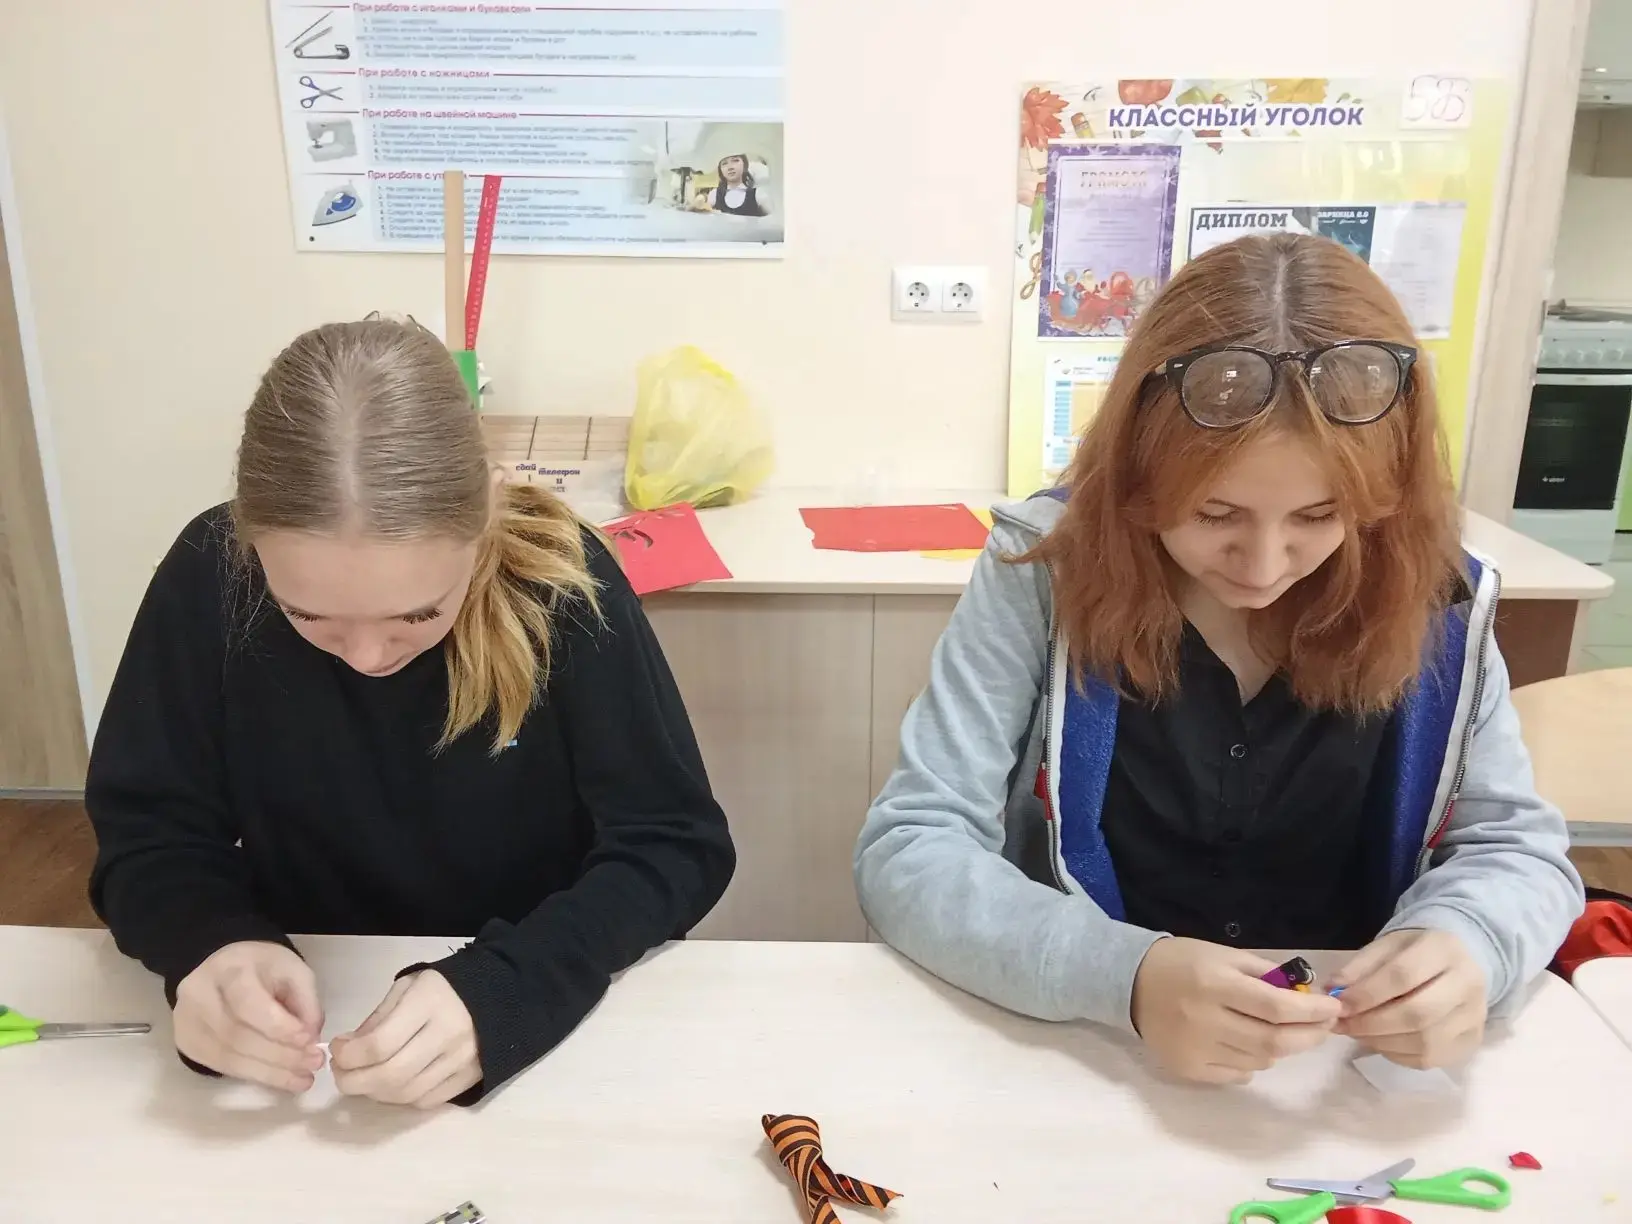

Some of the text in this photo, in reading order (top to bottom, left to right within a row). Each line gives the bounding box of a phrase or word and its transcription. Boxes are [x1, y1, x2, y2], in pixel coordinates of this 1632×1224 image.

[358, 68, 378, 78] При
[380, 68, 417, 78] работе
[429, 71, 490, 79] ножницами
[362, 108, 381, 118] При
[383, 109, 418, 118] работе
[434, 110, 476, 119] швейной
[478, 112, 518, 120] машине
[1109, 103, 1364, 127] КЛАССНЫЙ УГОЛОК
[367, 170, 386, 179] При
[388, 171, 422, 180] работе
[1196, 213, 1288, 231] ДИПЛОМ
[538, 468, 580, 476] телефон
